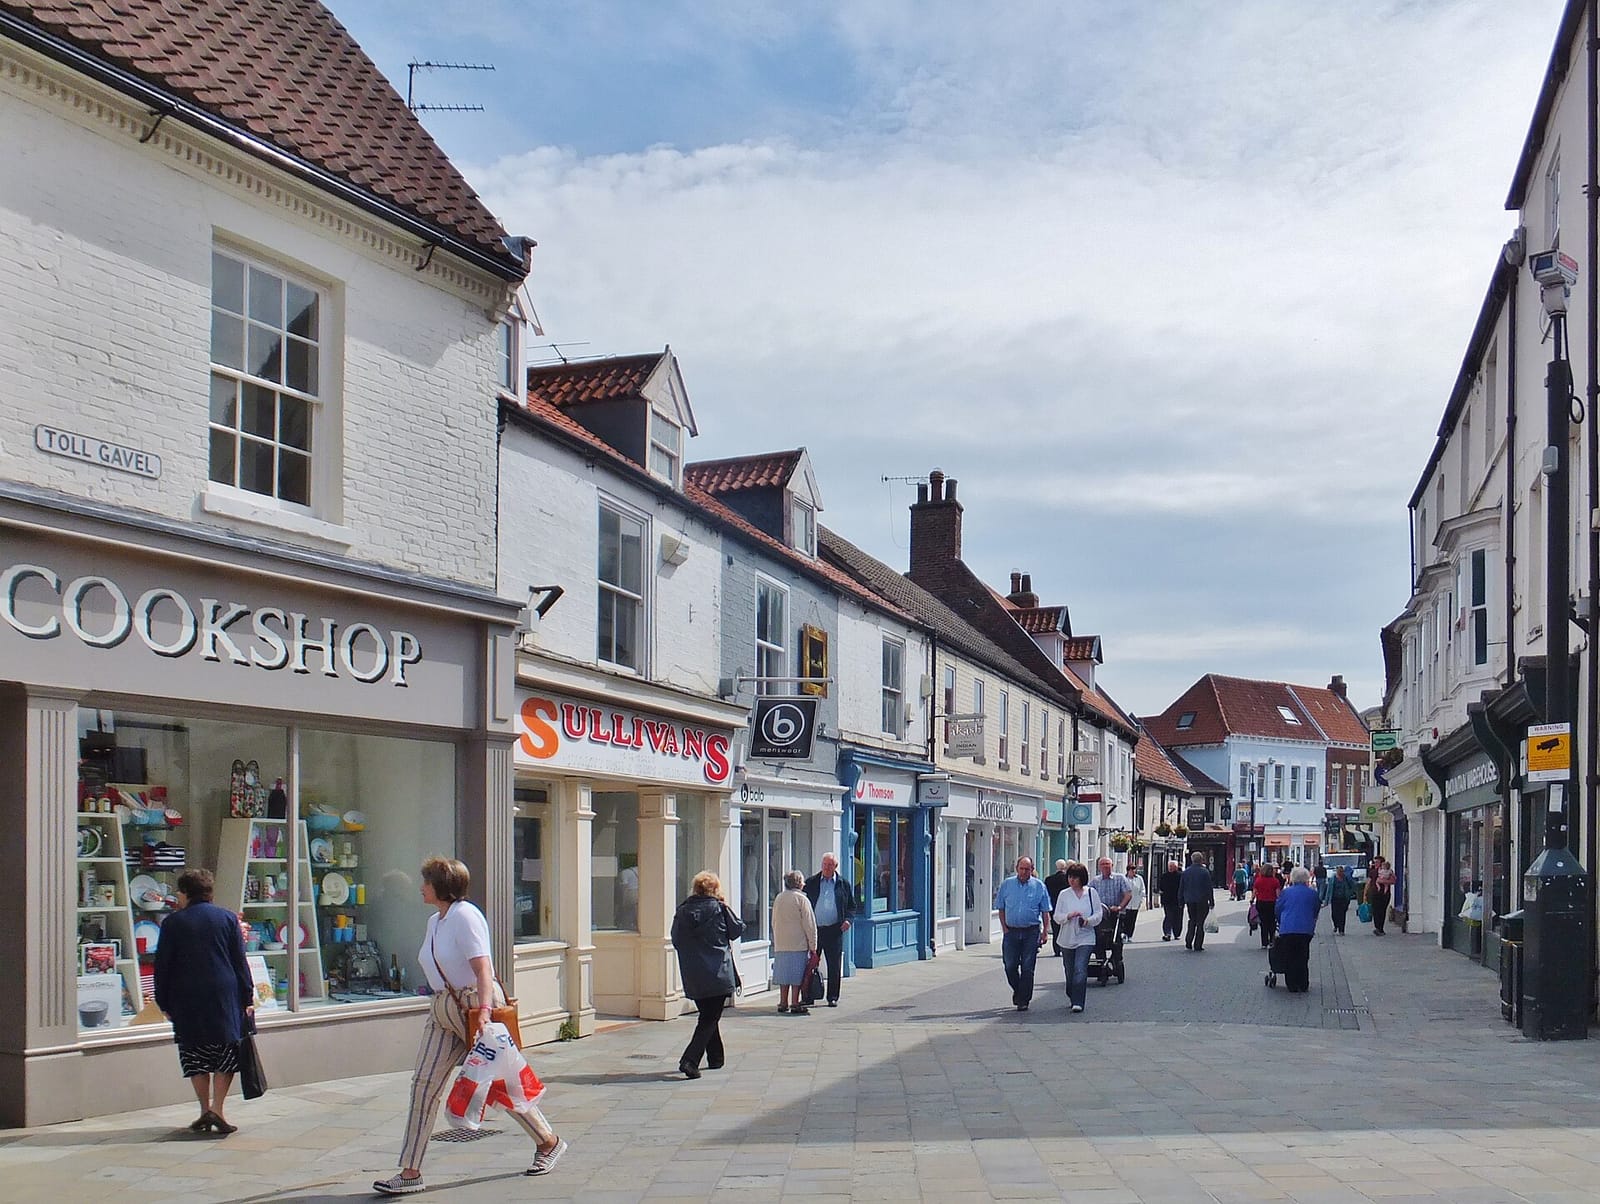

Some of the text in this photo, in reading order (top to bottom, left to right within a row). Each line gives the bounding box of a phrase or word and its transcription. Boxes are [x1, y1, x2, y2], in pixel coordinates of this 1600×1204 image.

[43, 429, 155, 474] TOLL GAVEL
[0, 564, 422, 688] COOKSHOP
[520, 697, 731, 783] SULLIVANS
[1534, 724, 1564, 732] WARNING
[759, 746, 802, 755] menswear
[868, 782, 895, 801] Thomson
